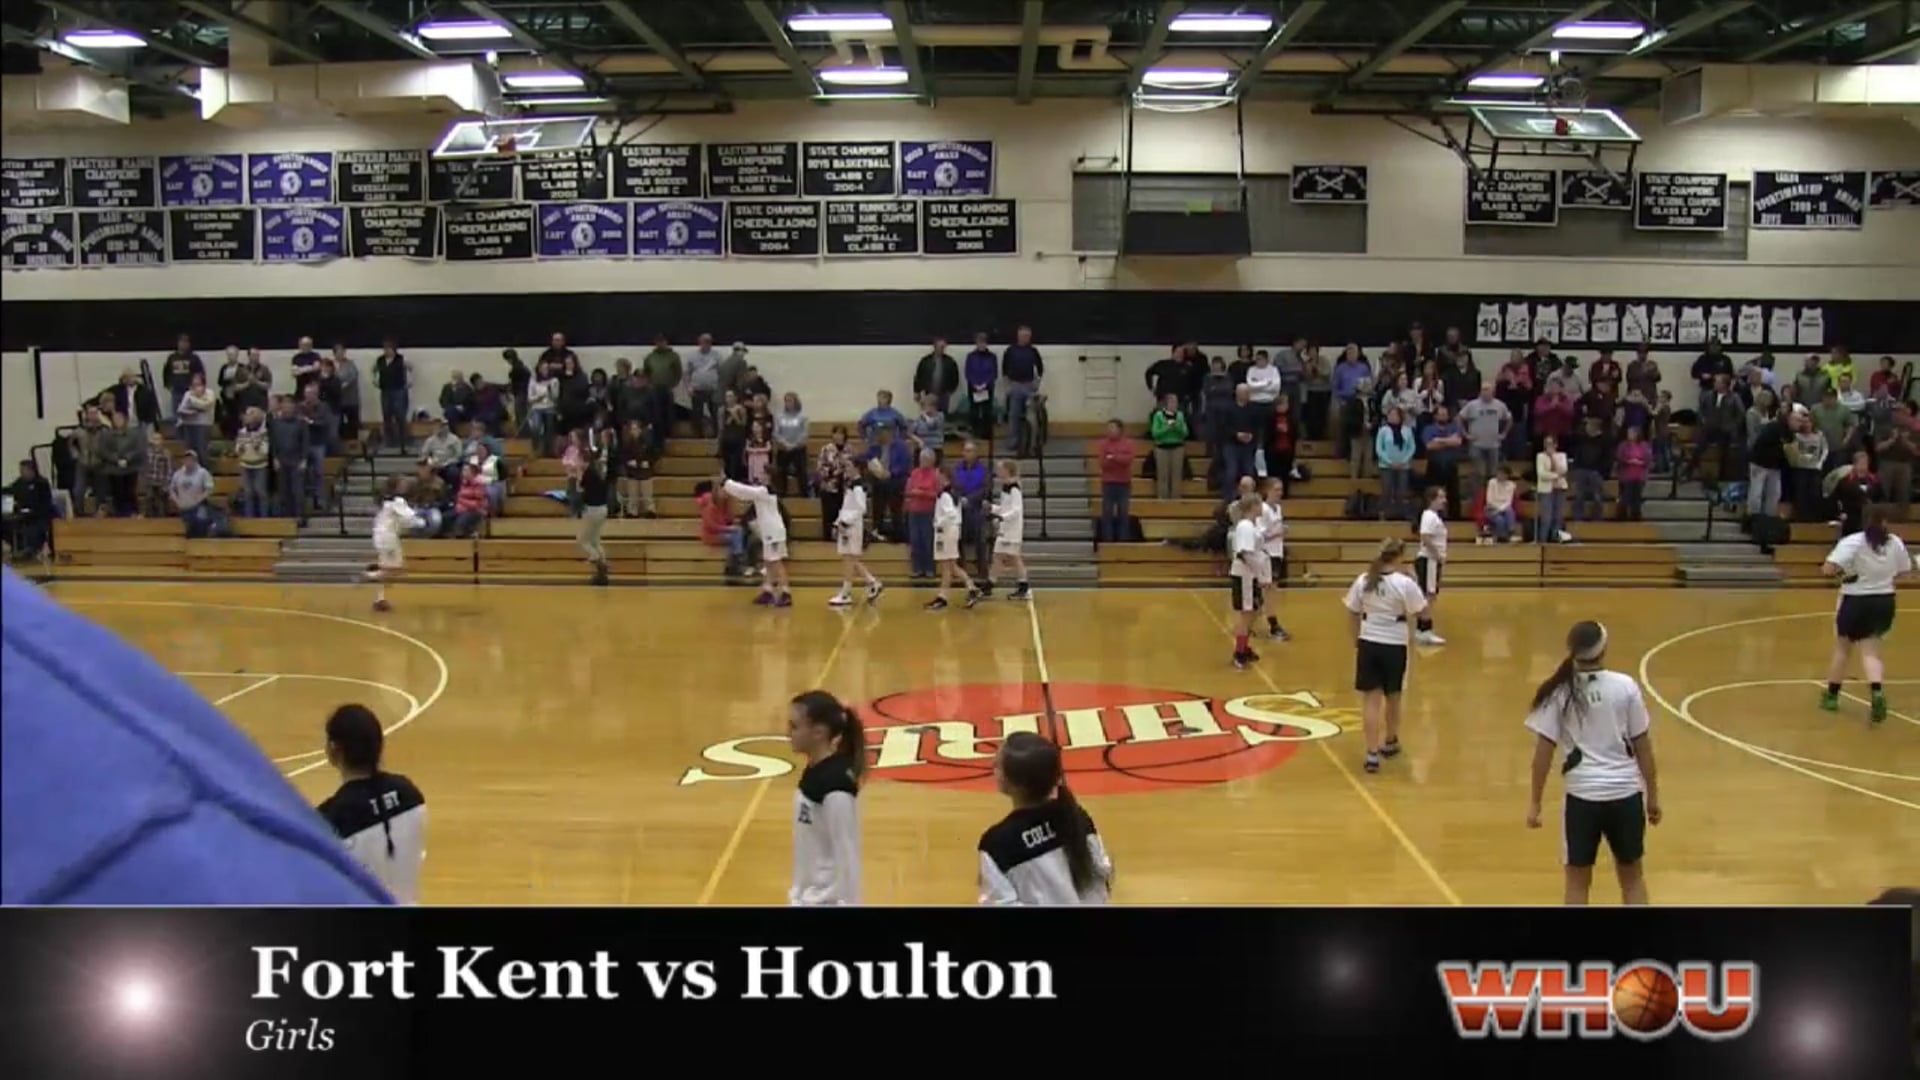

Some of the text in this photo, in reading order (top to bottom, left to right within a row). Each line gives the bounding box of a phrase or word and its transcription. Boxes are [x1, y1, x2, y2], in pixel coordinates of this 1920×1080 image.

[808, 145, 889, 156] STATE CHAMPIONS
[627, 157, 687, 168] CHAMPIONS
[721, 155, 783, 166] CHAMPIONS
[832, 158, 892, 169] BASKETBALL
[825, 171, 875, 181] CLASS C
[1503, 171, 1552, 182] CHAMPIONS
[1673, 175, 1720, 187] CHAMPIONS
[1498, 181, 1545, 192] CHAMPIONS
[1669, 186, 1715, 197] CHAMPIONS
[735, 203, 815, 216] STATE CHAMPIONS
[828, 202, 855, 214] STATE
[930, 202, 1009, 215] STATE CHAMPIONS
[475, 208, 533, 222] CHAMPIONS
[364, 219, 422, 229] CHAMPIONS
[733, 217, 817, 229] CHEERLEADING
[928, 215, 1010, 228] CHEERLEADING
[447, 222, 529, 235] CHEERLEADING
[945, 228, 983, 239] CLASS
[750, 230, 788, 240] CLASS
[846, 242, 885, 252] CLASS
[1480, 317, 1499, 337] 40
[1654, 321, 1673, 340] 32
[1710, 322, 1729, 341] 34
